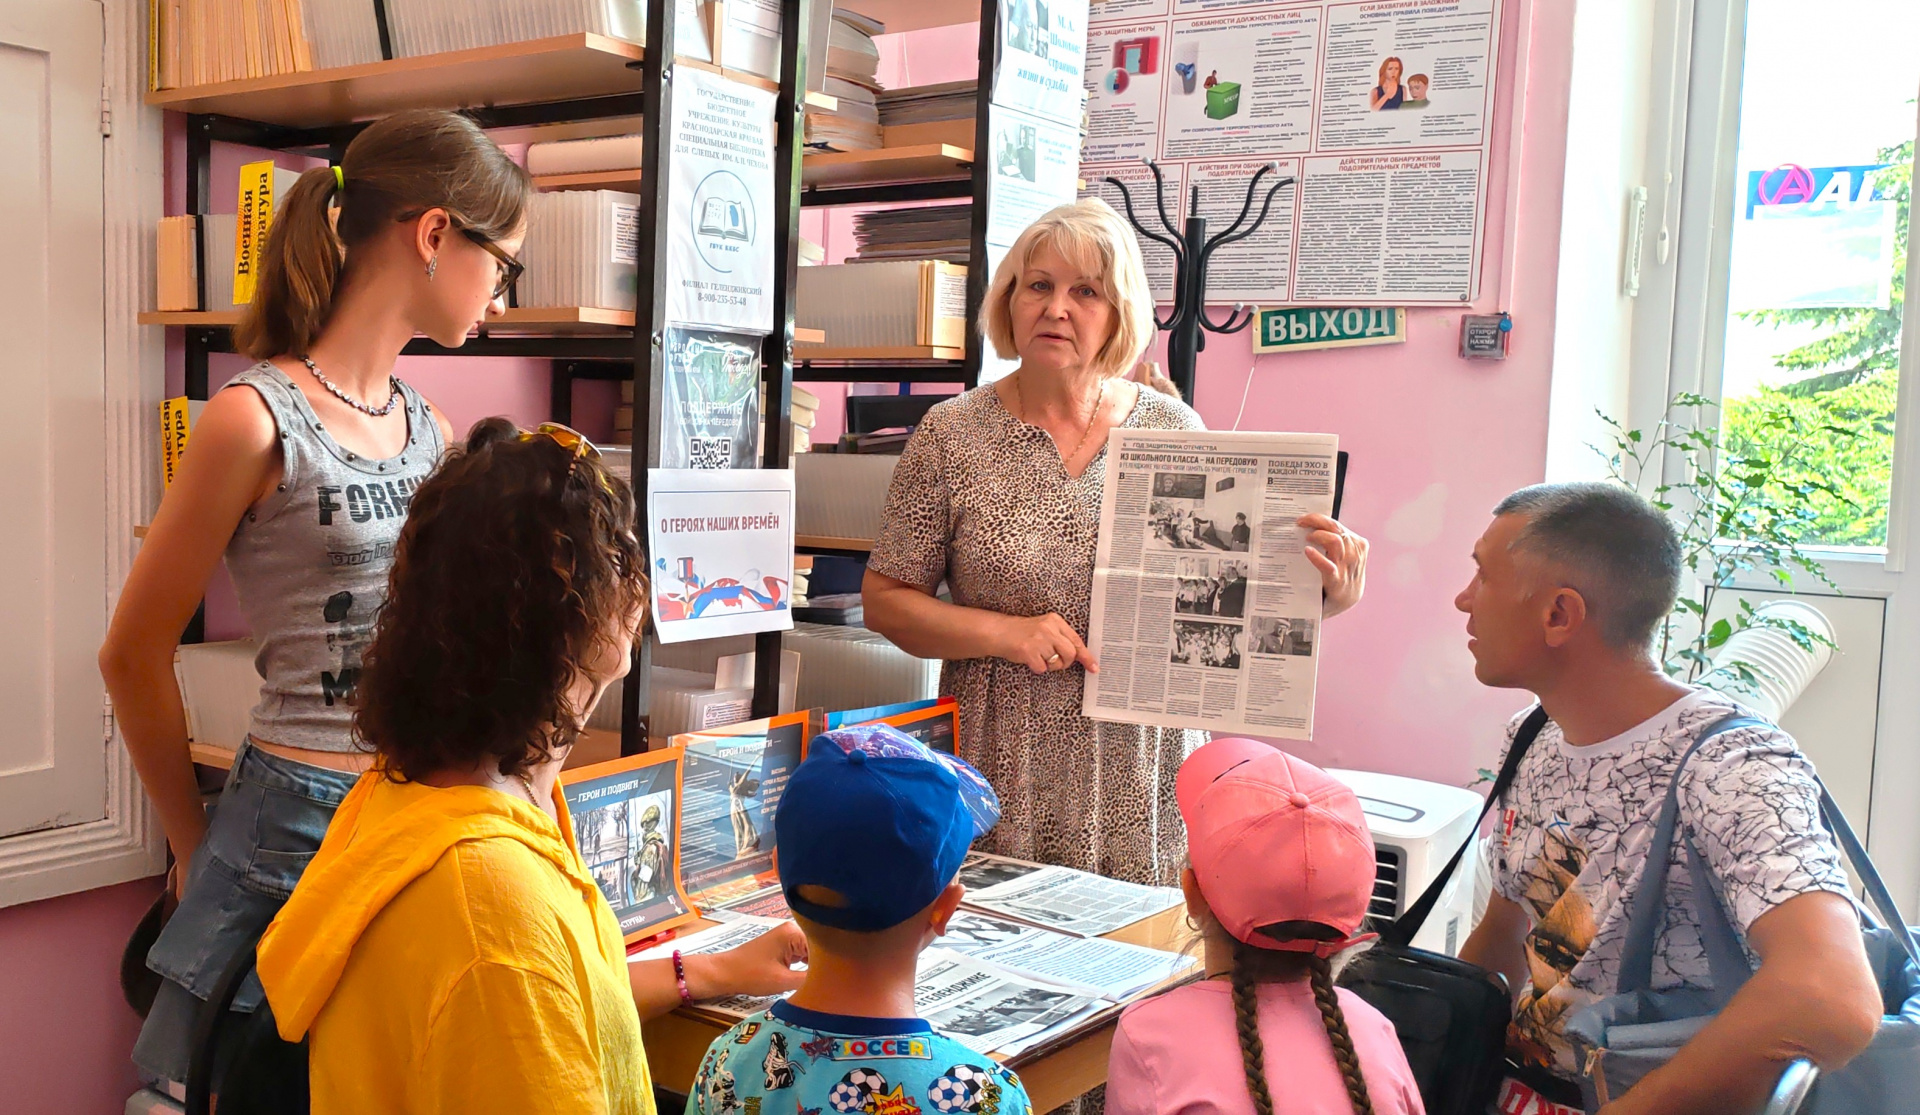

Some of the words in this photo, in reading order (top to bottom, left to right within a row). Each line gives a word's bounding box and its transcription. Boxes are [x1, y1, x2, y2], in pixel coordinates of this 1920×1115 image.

[1376, 1, 1413, 11] ЗАХВАТИЛИ
[1421, 5, 1459, 13] ПОВЕДЕНИЯ
[1191, 17, 1235, 27] ОБЯЗАННОСТИ
[1236, 13, 1285, 24] ДОЛЖНОСТНЫХ
[1286, 12, 1301, 20] ЛИЦ
[1105, 27, 1137, 36] ЗАЩИТНЫЕ
[688, 109, 730, 126] УЧРЕЖДЕНИЕ
[682, 120, 738, 139] КРАСНОДАРСКАЯ
[679, 132, 729, 150] СПЕЦИАЛЬНАЯ
[675, 144, 690, 154] ДЛЯ
[1340, 157, 1373, 165] ДЕЙСТВИЯ
[1390, 155, 1441, 163] ОБНАРУЖЕНИИ
[1198, 164, 1228, 172] ДЕЙСТВИЯ
[1338, 164, 1399, 172] ПОДОЗРИТЕЛЬНЫХ
[238, 189, 253, 275] Военная
[682, 279, 708, 290] ФИЛИАЛ
[711, 282, 762, 296] ГЕЛЕНДЖИКСКИЙ
[1268, 307, 1391, 342] ВЫХОД
[681, 400, 744, 415] ПОДДЕРЖИТЕ
[1120, 452, 1129, 460] ИЗ
[1130, 453, 1171, 463] ШКОЛЬНОГО
[1172, 455, 1199, 464] КЛАССА
[1205, 457, 1214, 465] НА
[1215, 457, 1258, 467] ПЕРЕДОВУЮ
[1268, 460, 1303, 469] ПОБЕДЫ
[1304, 461, 1321, 469] ЭХО
[661, 518, 668, 534] О
[670, 517, 705, 533] ГЕРОЯХ
[707, 515, 740, 532] НАШИХ
[742, 512, 780, 531] ВРЕМЁН
[577, 789, 601, 804] ГЕРОИ
[600, 787, 607, 797] И
[607, 779, 639, 796] ПОДВИГИ
[920, 972, 991, 1004] ГЕЛЕНДЖИКЕ
[843, 1038, 924, 1057] SOCCER
